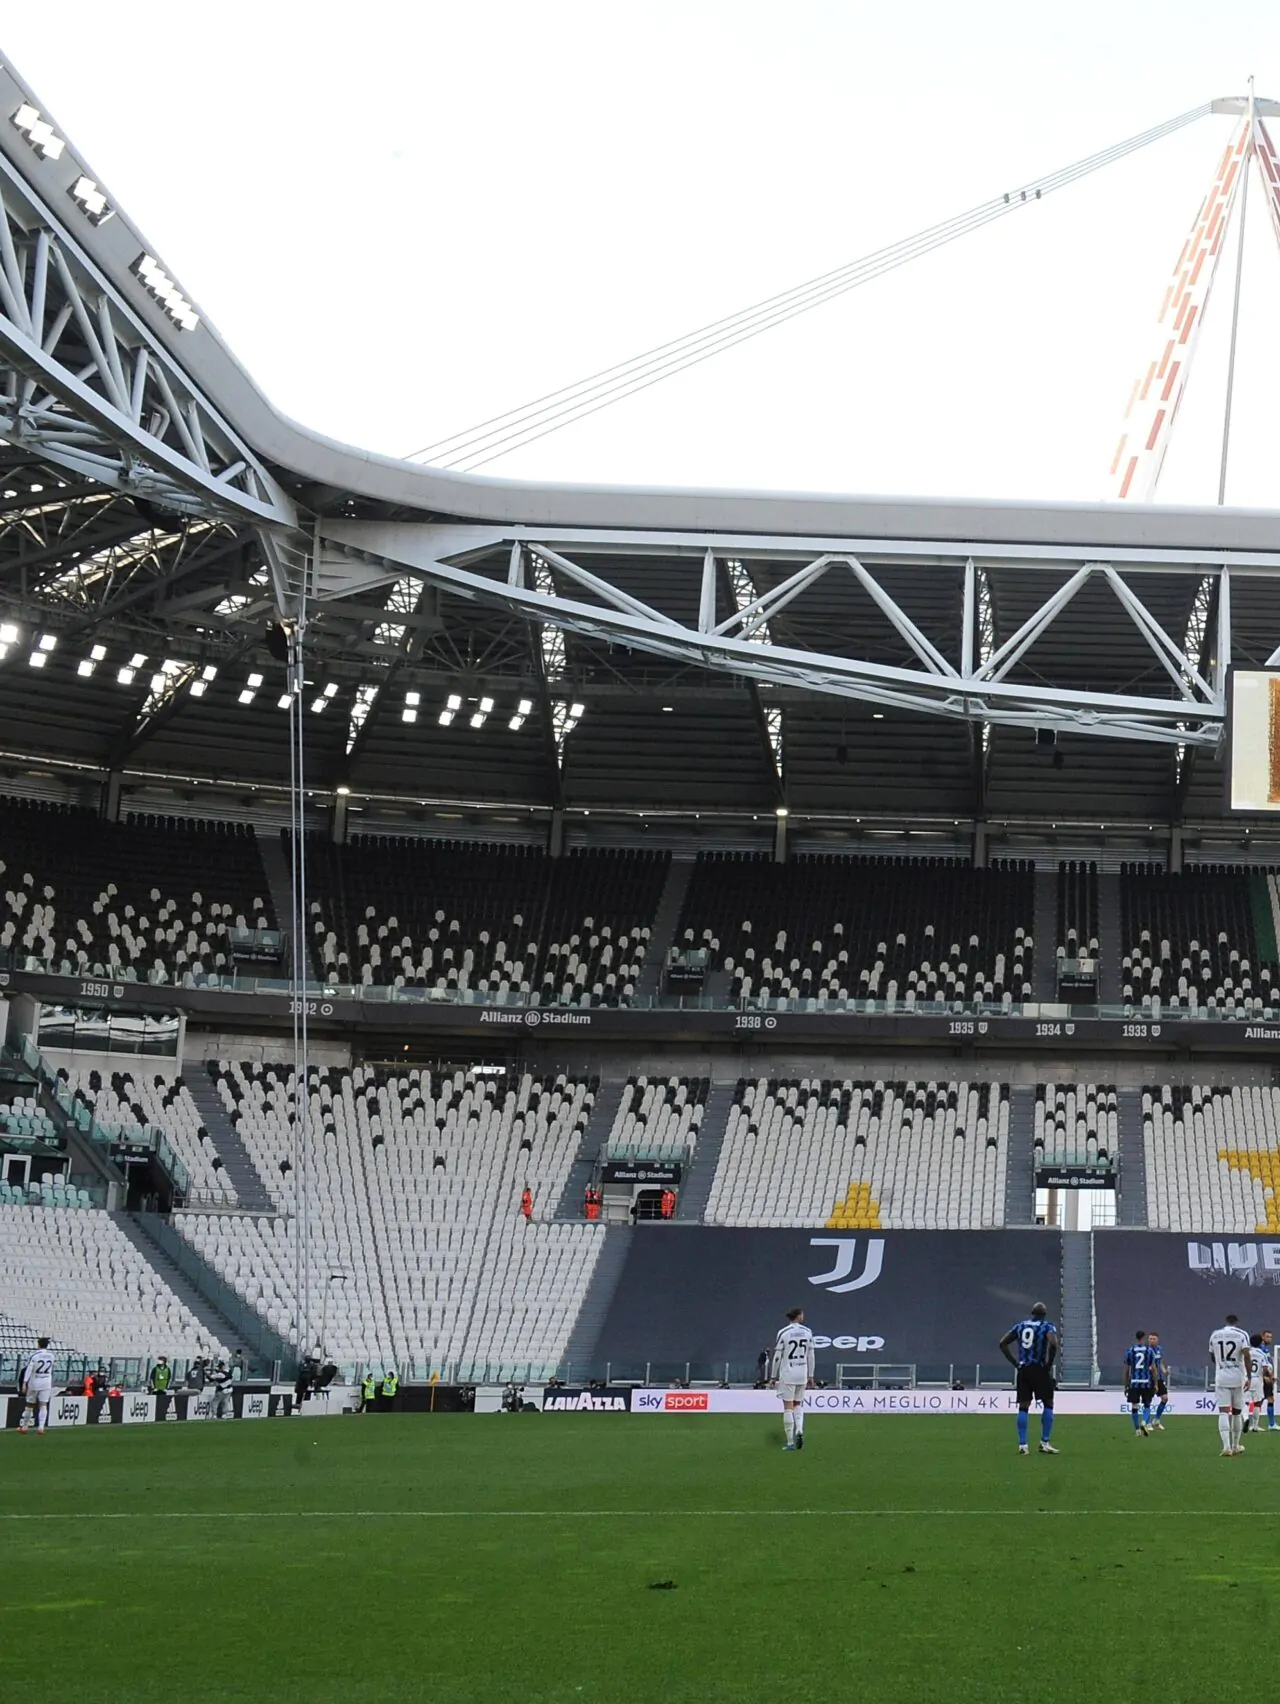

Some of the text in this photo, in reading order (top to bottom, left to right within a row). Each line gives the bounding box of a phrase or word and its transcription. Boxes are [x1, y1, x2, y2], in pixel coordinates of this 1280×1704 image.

[80, 982, 109, 997] 1950
[480, 1010, 592, 1025] Allianz Stadium
[735, 1015, 761, 1028] 1938
[949, 1022, 974, 1034] 1935
[1036, 1023, 1061, 1036] 1934
[1122, 1025, 1148, 1037] 1933
[812, 1335, 885, 1352] eep
[1021, 1327, 1034, 1349] 9
[787, 1338, 807, 1360] 25
[1217, 1340, 1237, 1362] 12
[35, 1359, 53, 1375] 22
[1135, 1352, 1145, 1369] 2
[129, 1396, 149, 1421] Jeep
[194, 1396, 211, 1420] Jeep
[248, 1395, 263, 1417] Jeep
[543, 1391, 626, 1411] LAVAZZA
[639, 1393, 706, 1410] sky sport
[801, 1395, 1043, 1409] NCORA MEGLIO IN 4K HR
[58, 1397, 80, 1425] Jeep
